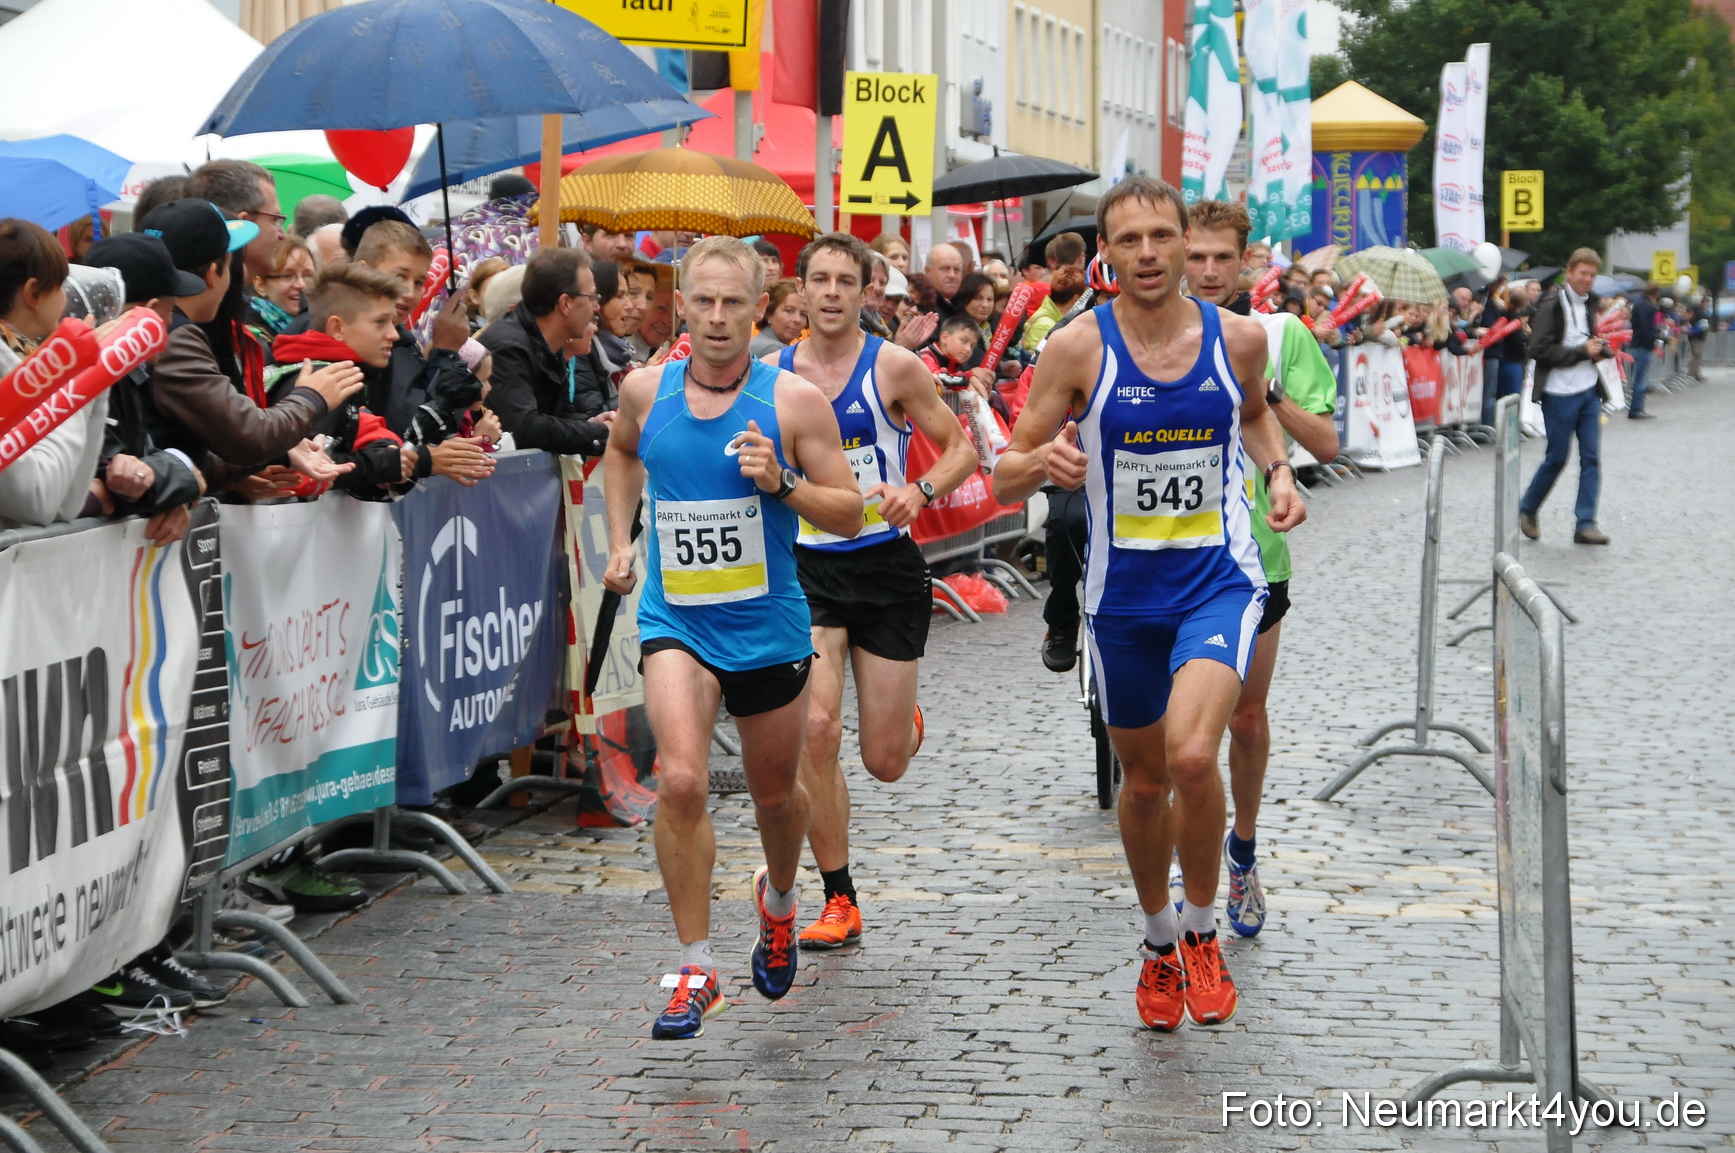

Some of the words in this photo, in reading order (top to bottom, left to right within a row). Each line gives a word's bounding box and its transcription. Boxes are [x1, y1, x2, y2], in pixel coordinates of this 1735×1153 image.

[855, 77, 926, 104] Block
[860, 115, 913, 183] A
[1509, 173, 1539, 184] Block
[1514, 188, 1534, 216] B
[994, 325, 1012, 350] BKK
[1117, 386, 1156, 397] HEITEC
[1198, 384, 1220, 392] adidas
[0, 426, 28, 467] di
[25, 378, 87, 436] BKK
[1123, 430, 1154, 444] LAC
[1155, 428, 1215, 444] QUELLE
[1116, 459, 1153, 474] PARTL
[1154, 459, 1206, 472] Neumarkt
[1136, 474, 1204, 512] 543
[656, 510, 687, 522] PARTL
[688, 510, 742, 522] Neumarkt
[674, 525, 743, 566] 555
